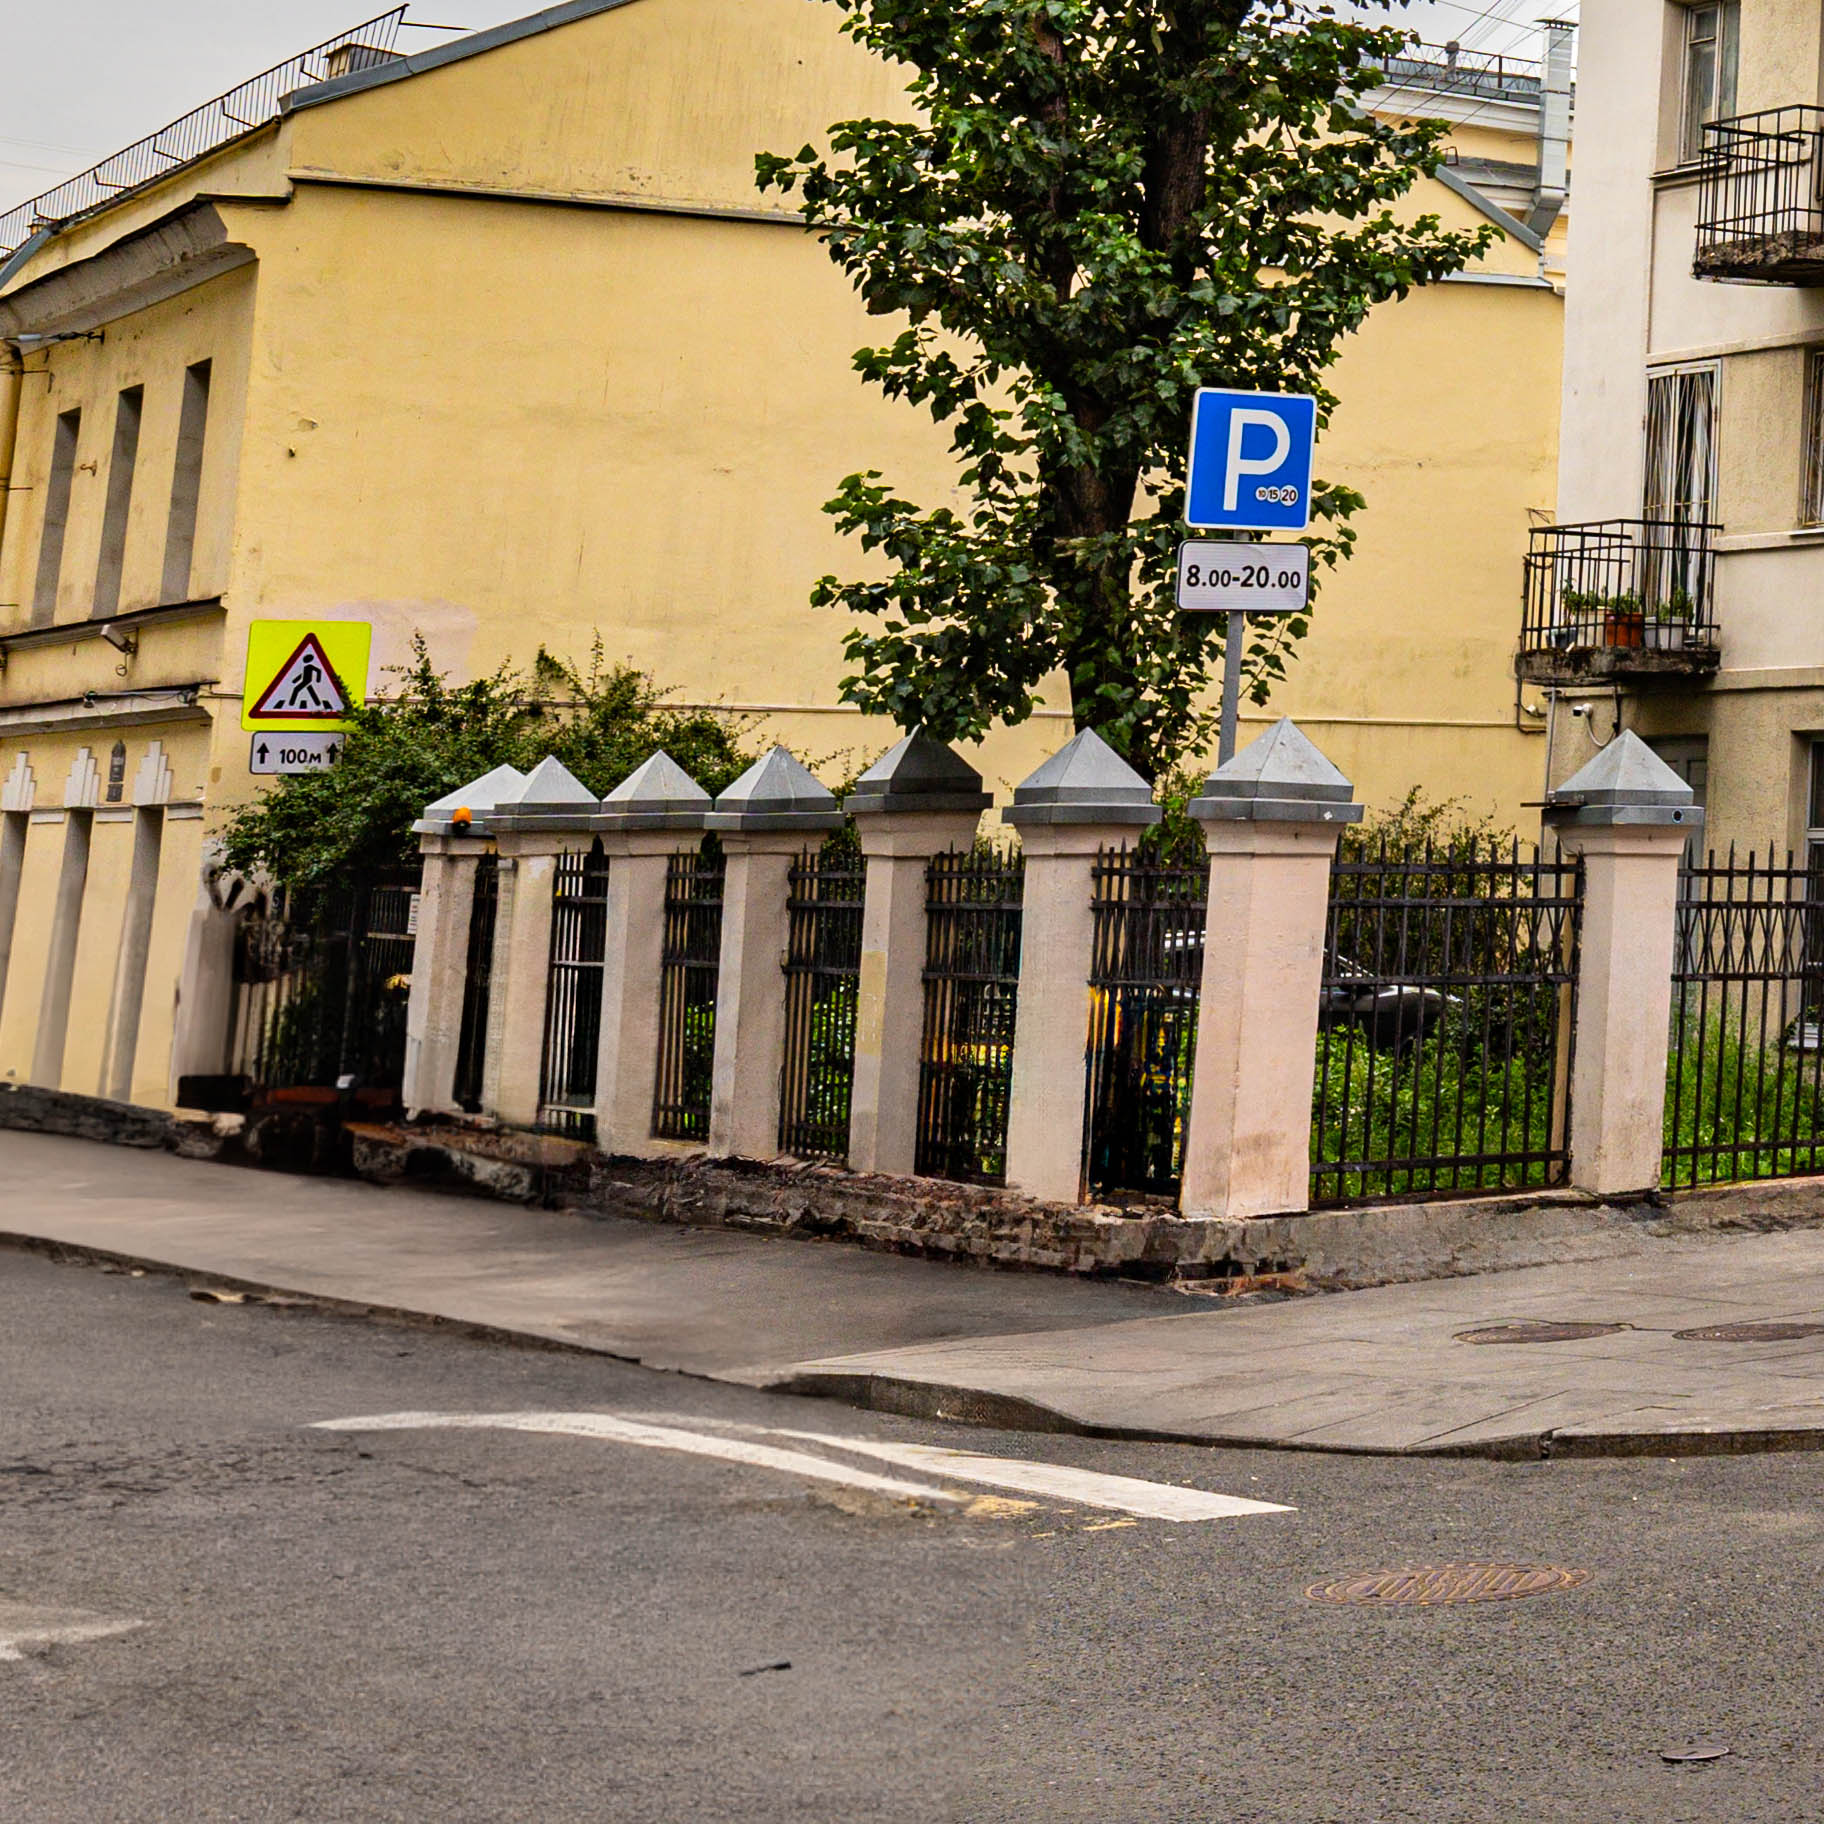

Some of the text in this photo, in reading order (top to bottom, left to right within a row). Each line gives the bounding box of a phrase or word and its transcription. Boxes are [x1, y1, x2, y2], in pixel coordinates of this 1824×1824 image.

[1223, 408, 1291, 511] P
[1268, 489, 1279, 500] 15
[1281, 489, 1297, 502] 20
[1186, 564, 1301, 588] 8.00-20.00
[279, 748, 322, 764] 100м
